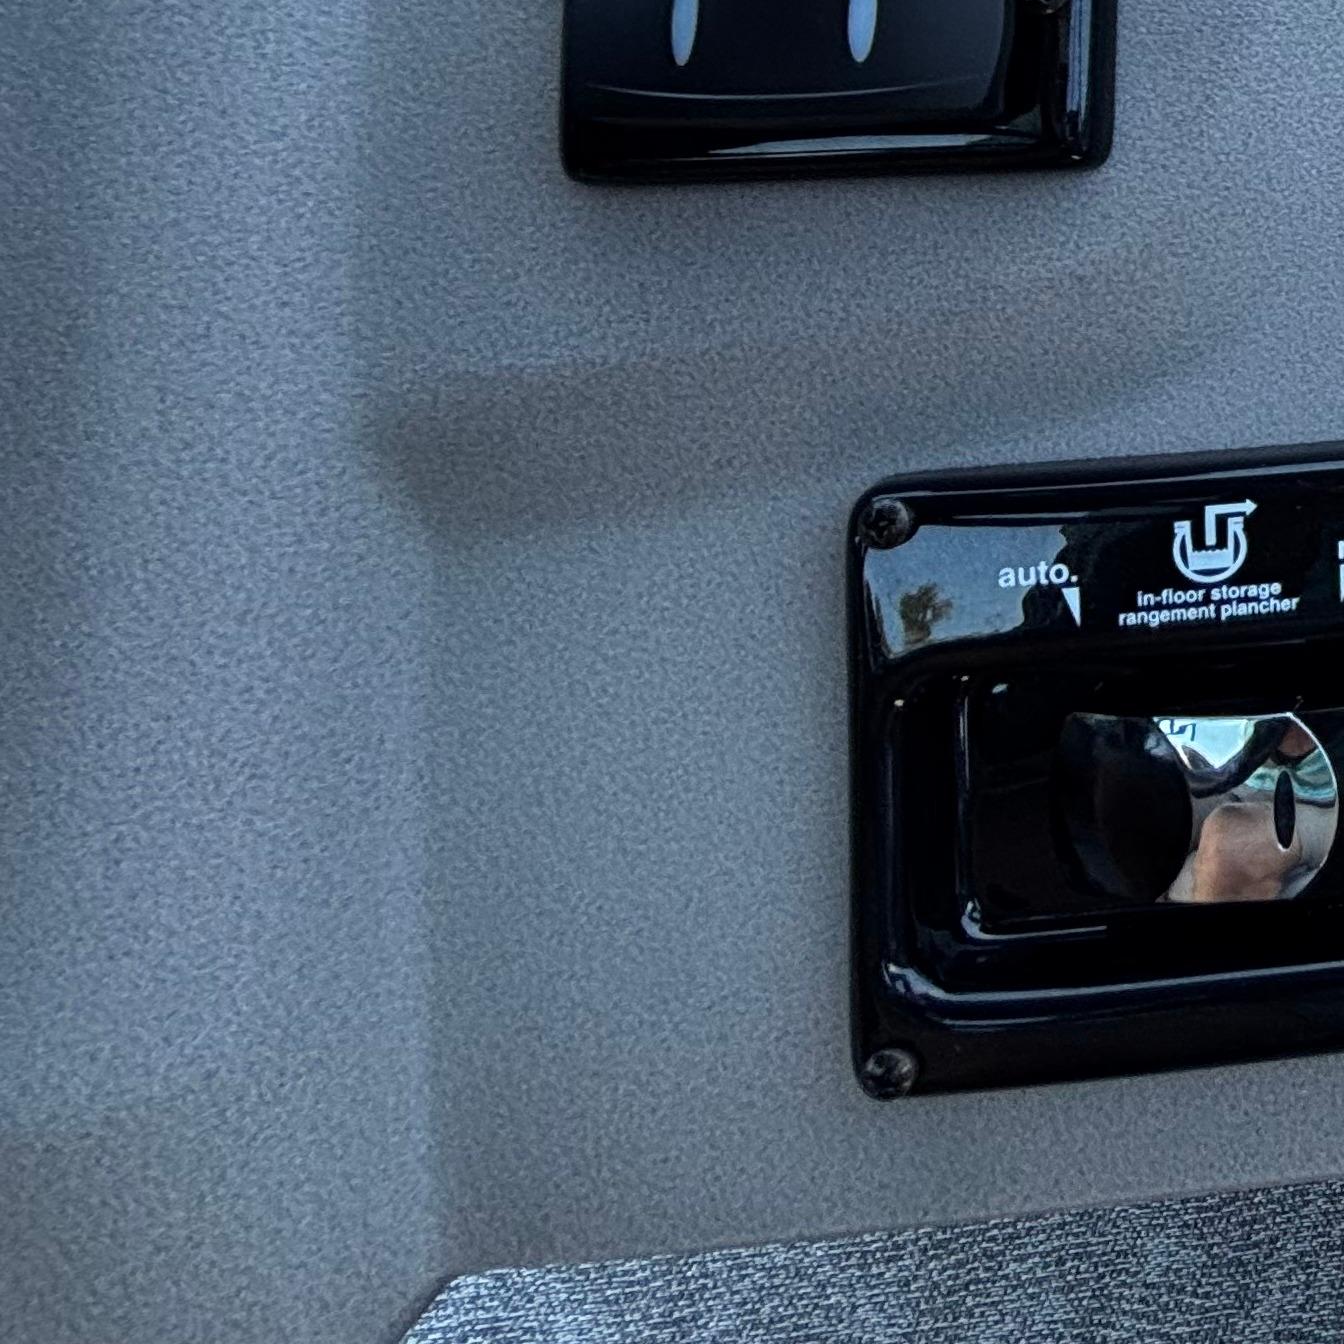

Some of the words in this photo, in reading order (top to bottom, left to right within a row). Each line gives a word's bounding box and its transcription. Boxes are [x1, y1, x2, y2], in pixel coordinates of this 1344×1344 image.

[998, 560, 1079, 588] auto.
[1137, 584, 1205, 607] in-floor
[1210, 581, 1282, 604] storage
[1118, 604, 1216, 628] rangement
[1220, 595, 1300, 622] plancher
